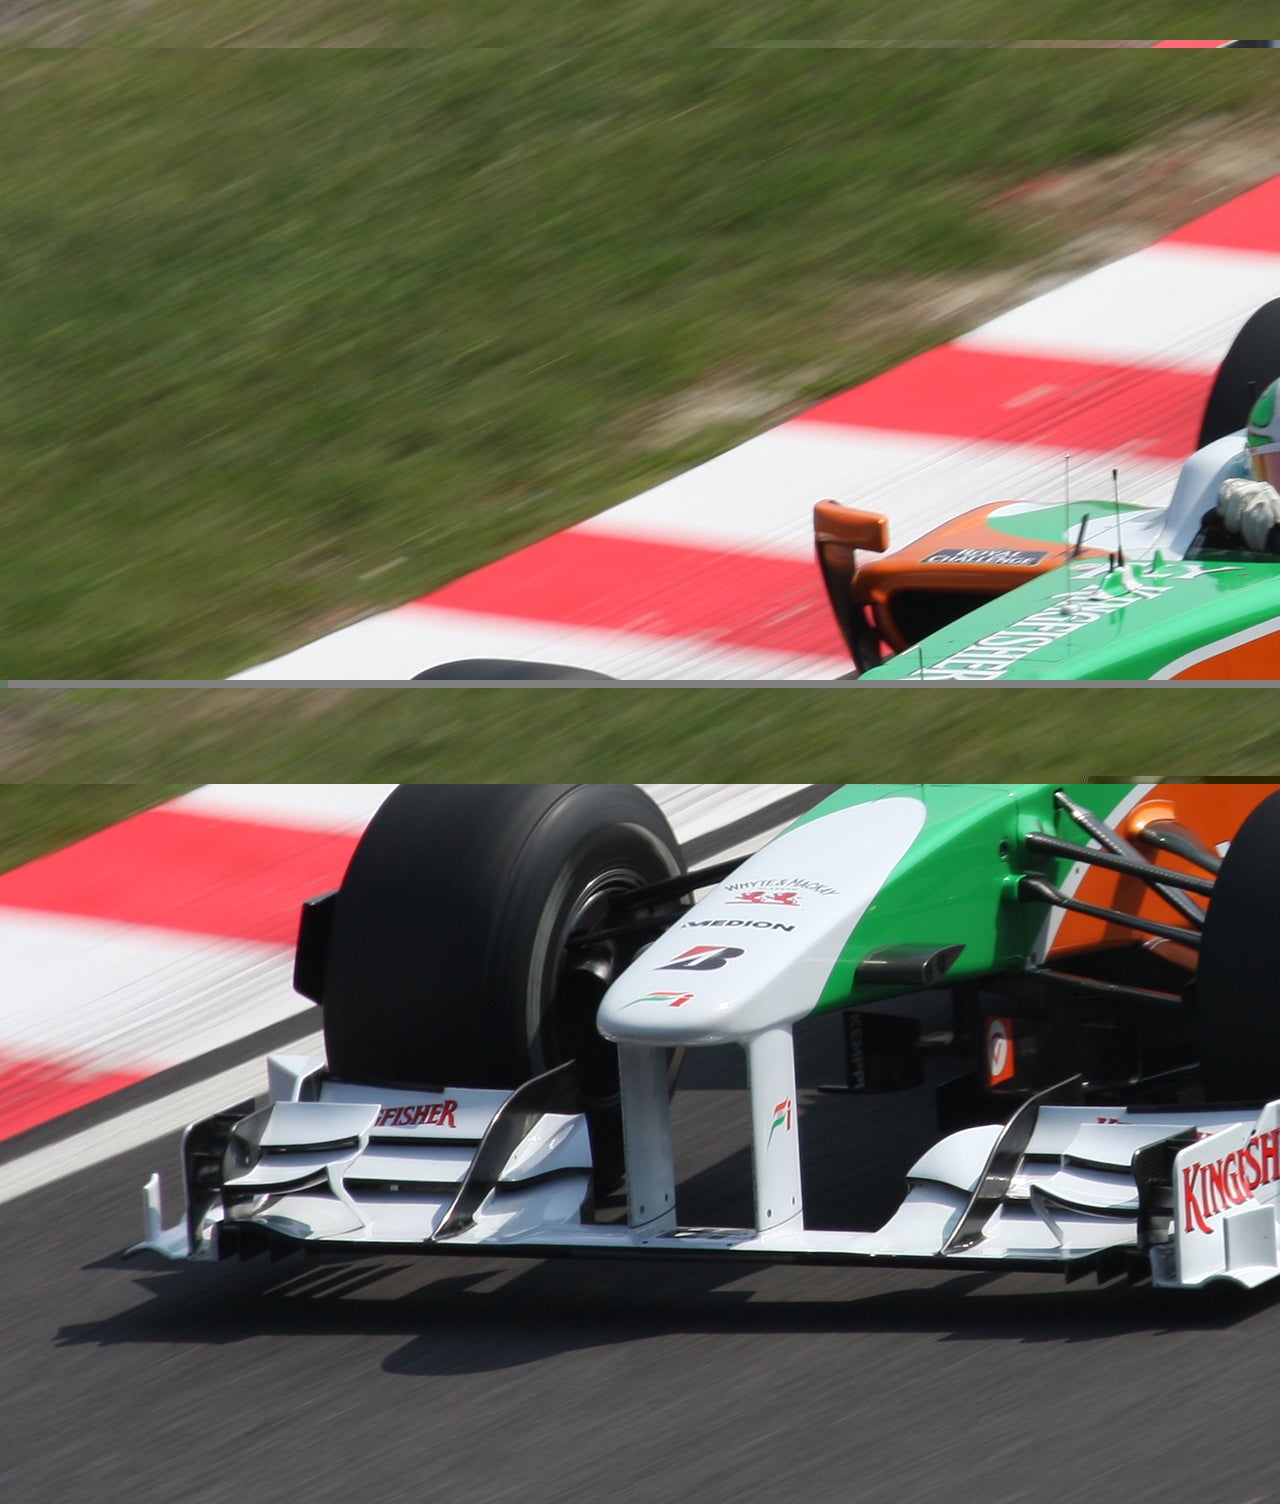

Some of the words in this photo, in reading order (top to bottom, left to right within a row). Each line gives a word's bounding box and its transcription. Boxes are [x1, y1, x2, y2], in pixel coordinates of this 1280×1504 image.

[724, 879, 774, 893] WHYTE
[680, 919, 796, 933] MEDION
[374, 1099, 459, 1129] FISHER
